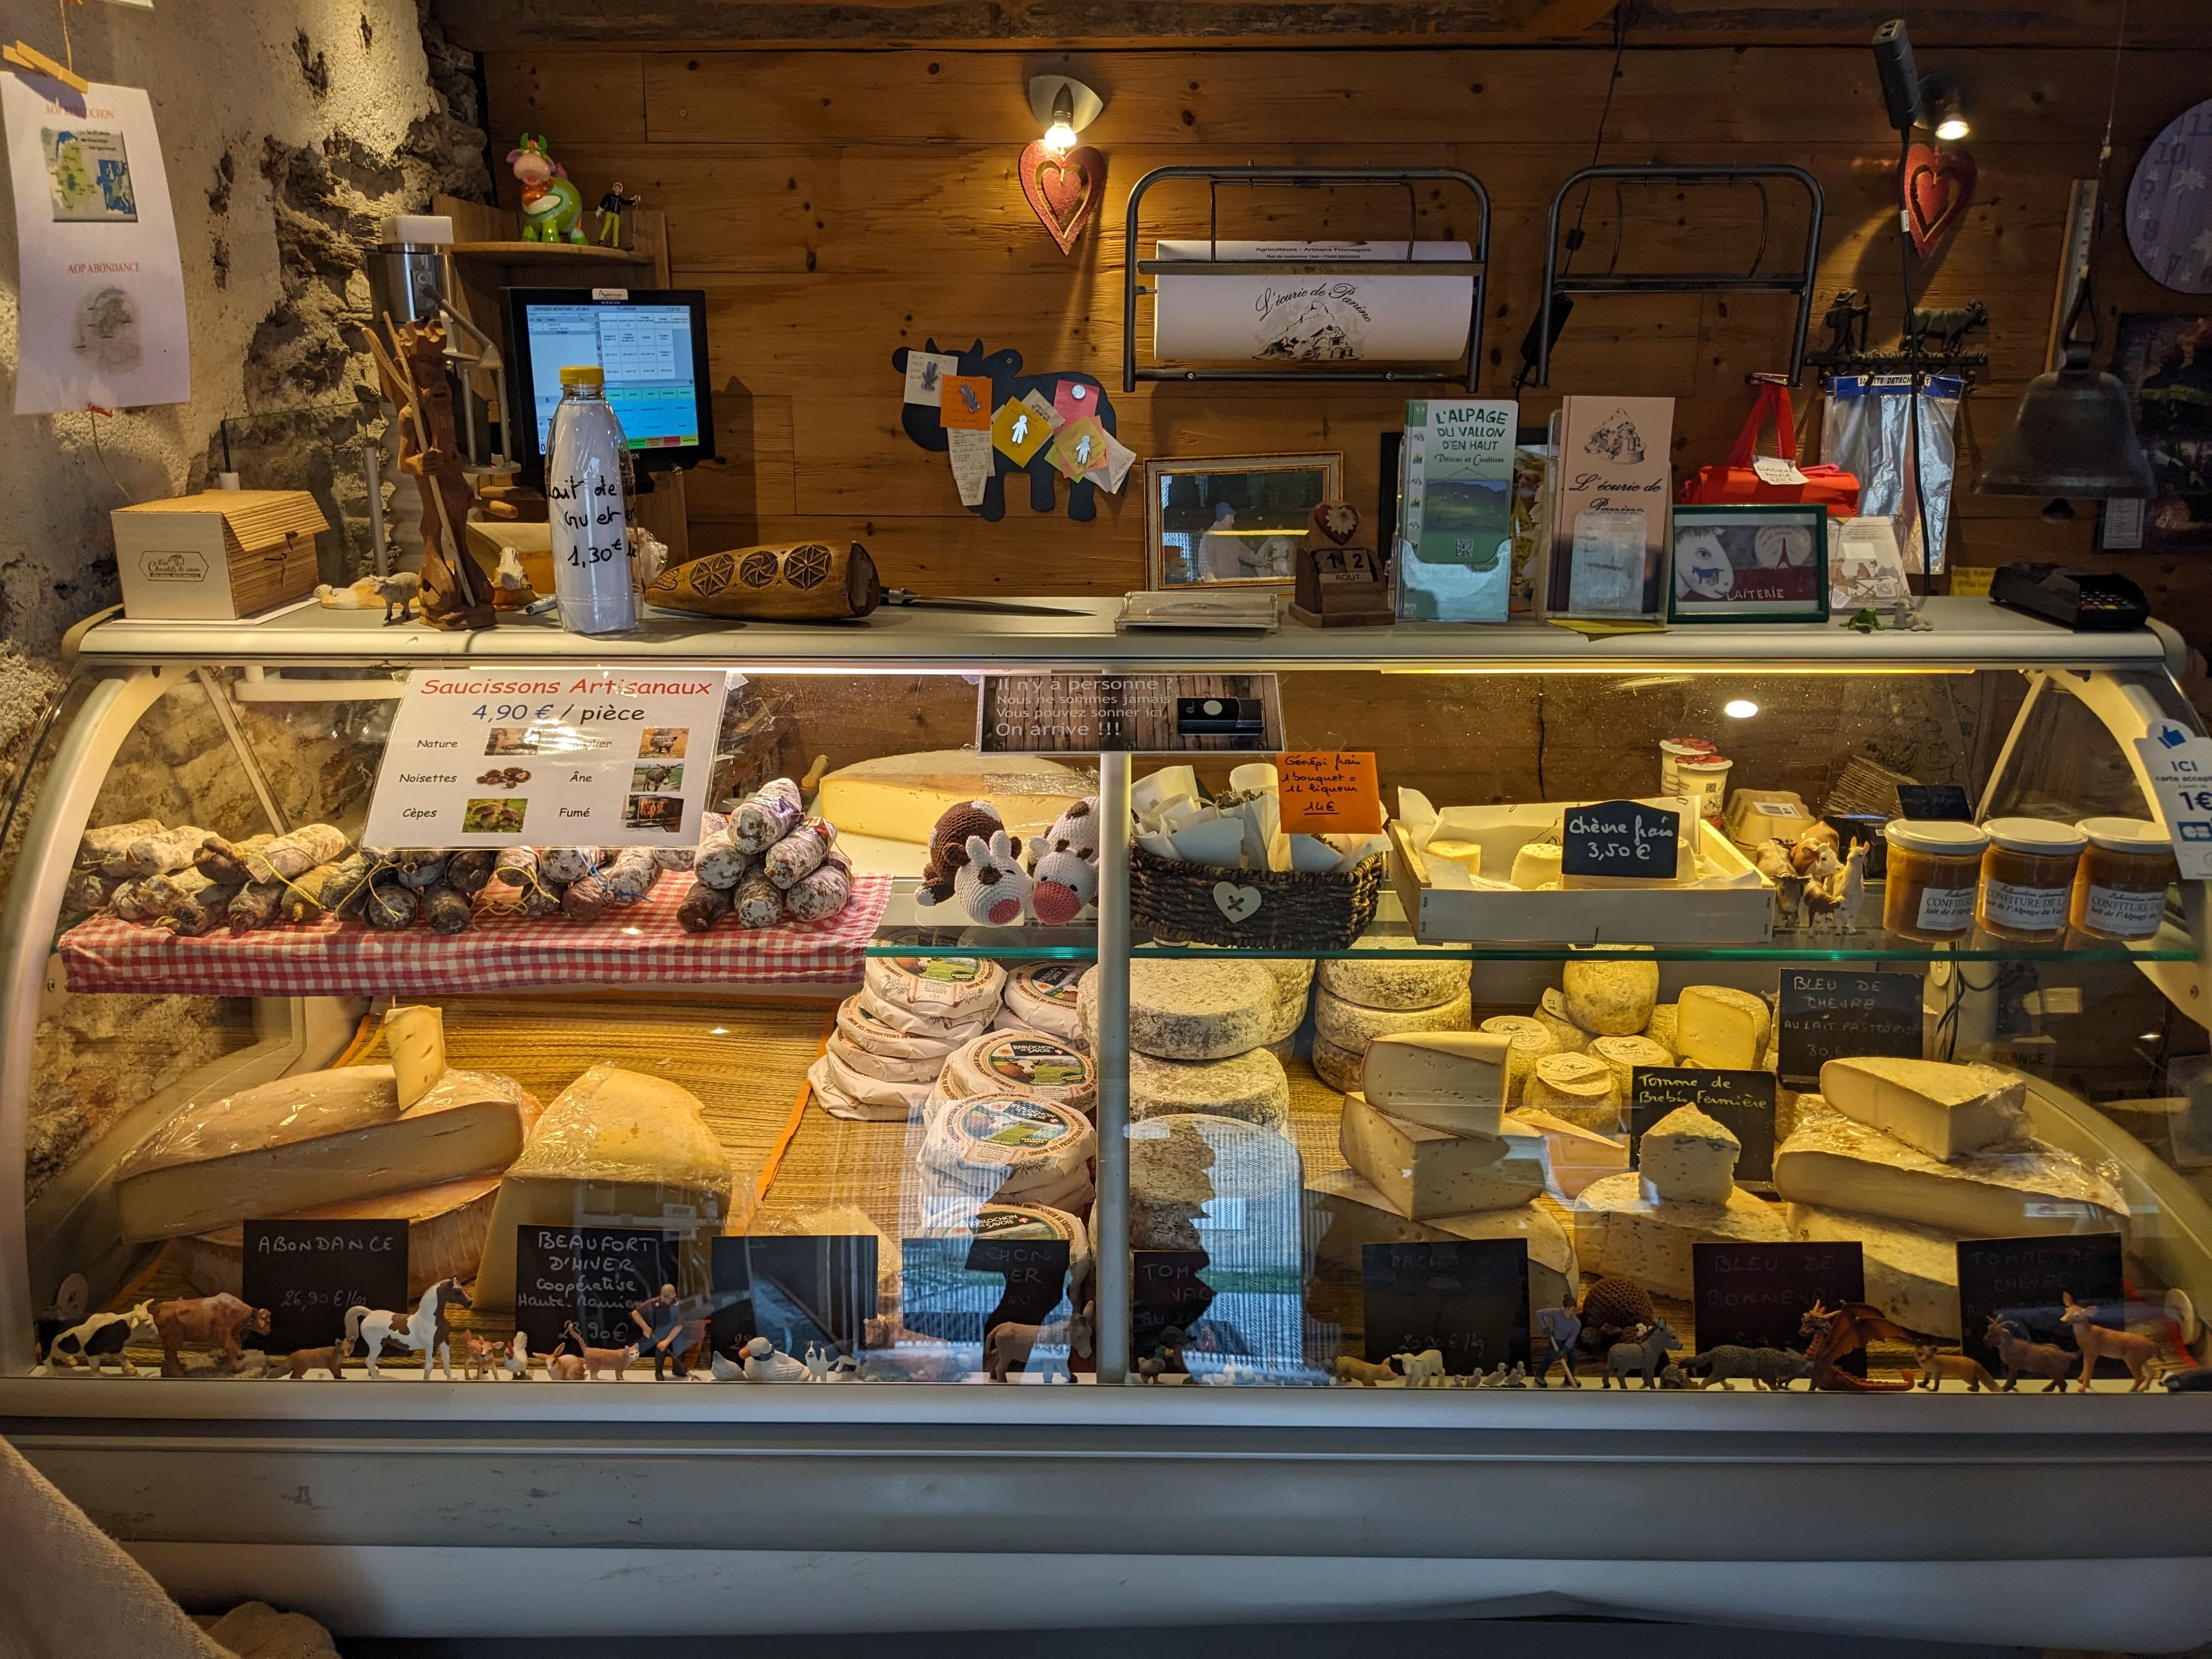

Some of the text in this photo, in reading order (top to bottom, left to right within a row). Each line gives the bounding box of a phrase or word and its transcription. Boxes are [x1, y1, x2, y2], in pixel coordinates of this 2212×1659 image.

[46, 105, 61, 115] AOP
[68, 263, 140, 273] AOP ABONDANCE
[1255, 287, 1308, 321] L'écurie
[1310, 283, 1327, 296] de
[1435, 408, 1508, 425] L'ALPAGE
[1437, 427, 1505, 438] DU VALLON
[1442, 441, 1498, 450] D'EN HAUT
[1473, 454, 1504, 466] Coulisses
[594, 475, 617, 496] de
[1569, 473, 1662, 492] L'écurie de
[420, 678, 713, 696] Saucissons Artisanaux
[998, 678, 1173, 693] Il n'y a personne ?
[997, 695, 1031, 704] Nous
[1059, 696, 1117, 704] sommes
[1122, 694, 1170, 706] jamais
[472, 704, 528, 723] 4,90
[534, 704, 554, 721] €
[580, 704, 646, 725] pièce
[997, 708, 1029, 718] Vous
[1035, 708, 1086, 720] pouvez
[1091, 709, 1140, 717] sonner
[996, 721, 1120, 736] On arrive !!!
[416, 739, 459, 749] Nature
[2171, 760, 2198, 771] ICI
[399, 771, 593, 783] Noisettes Âne
[1281, 774, 1289, 782] 1
[1293, 771, 1344, 785] bouquet
[402, 806, 590, 820] Cèpes Fumé
[1568, 814, 1628, 836] Chèvre
[1588, 842, 1651, 861] 3,50 €
[1986, 888, 2040, 908] CONFITURE
[2043, 899, 2055, 907] DE
[1793, 976, 1882, 992] BLEU DE
[865, 1028, 900, 1039] PRODUCTEURS
[992, 1075, 1016, 1090] FERMIERS
[1638, 1073, 1731, 1088] Tomme de
[1639, 1090, 1767, 1109] Brebis Fermière
[1011, 1103, 1056, 1119] REBLOCHON
[1019, 1110, 1046, 1120] SAVOIE
[1029, 1148, 1049, 1156] UNION
[987, 1219, 1015, 1229] SAVOIE
[259, 1236, 393, 1255] ABONDANCE
[538, 1232, 657, 1252] BEAUFORT
[549, 1256, 635, 1272] D'HIVER
[1715, 1254, 1836, 1274] BLEU DE
[537, 1274, 637, 1298] Coopérative
